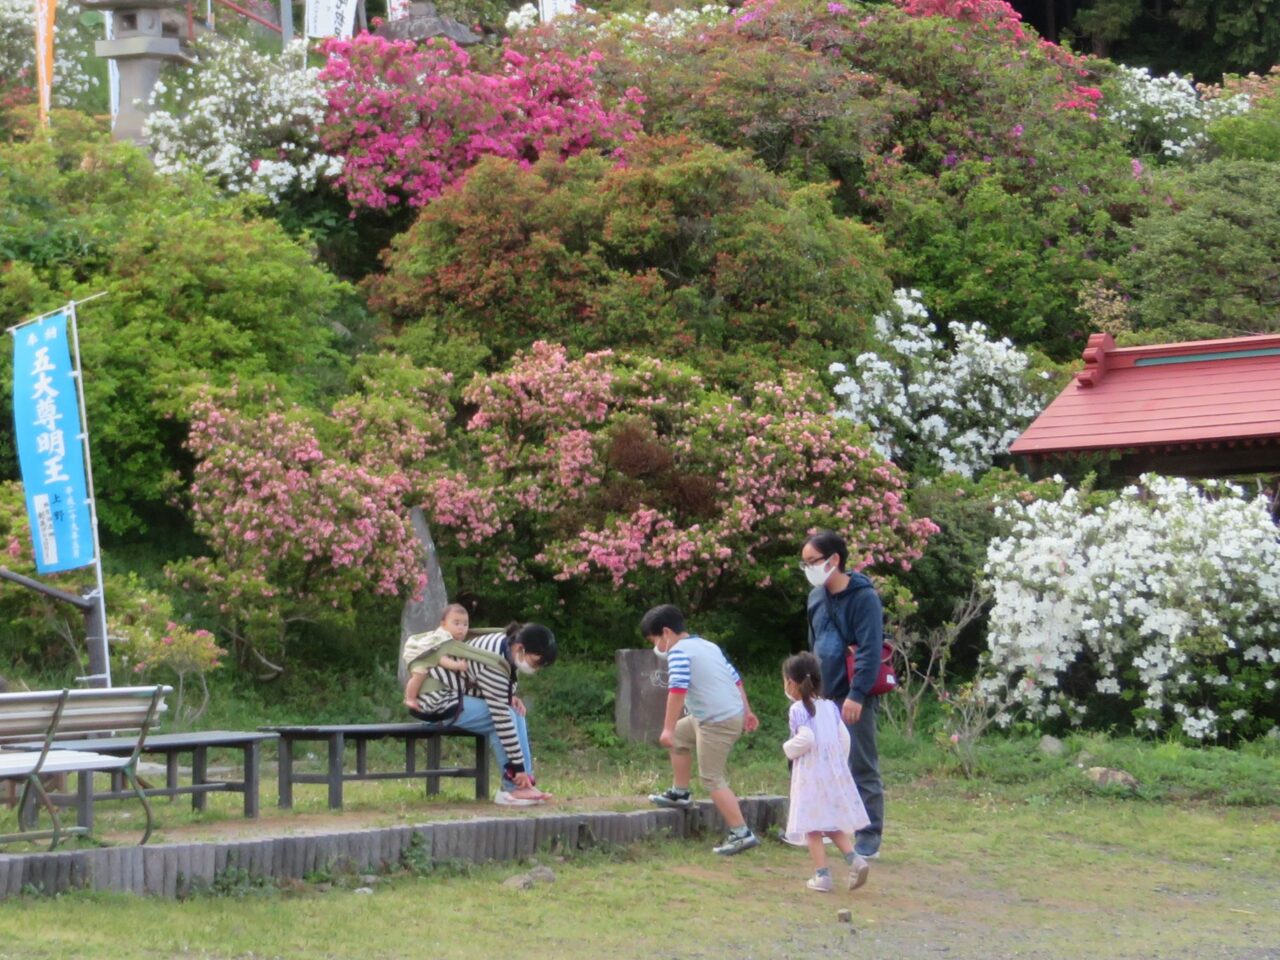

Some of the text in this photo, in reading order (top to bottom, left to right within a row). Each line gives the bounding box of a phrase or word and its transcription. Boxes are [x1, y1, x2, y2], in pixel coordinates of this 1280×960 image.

[30, 346, 70, 484] 五大尊明王
